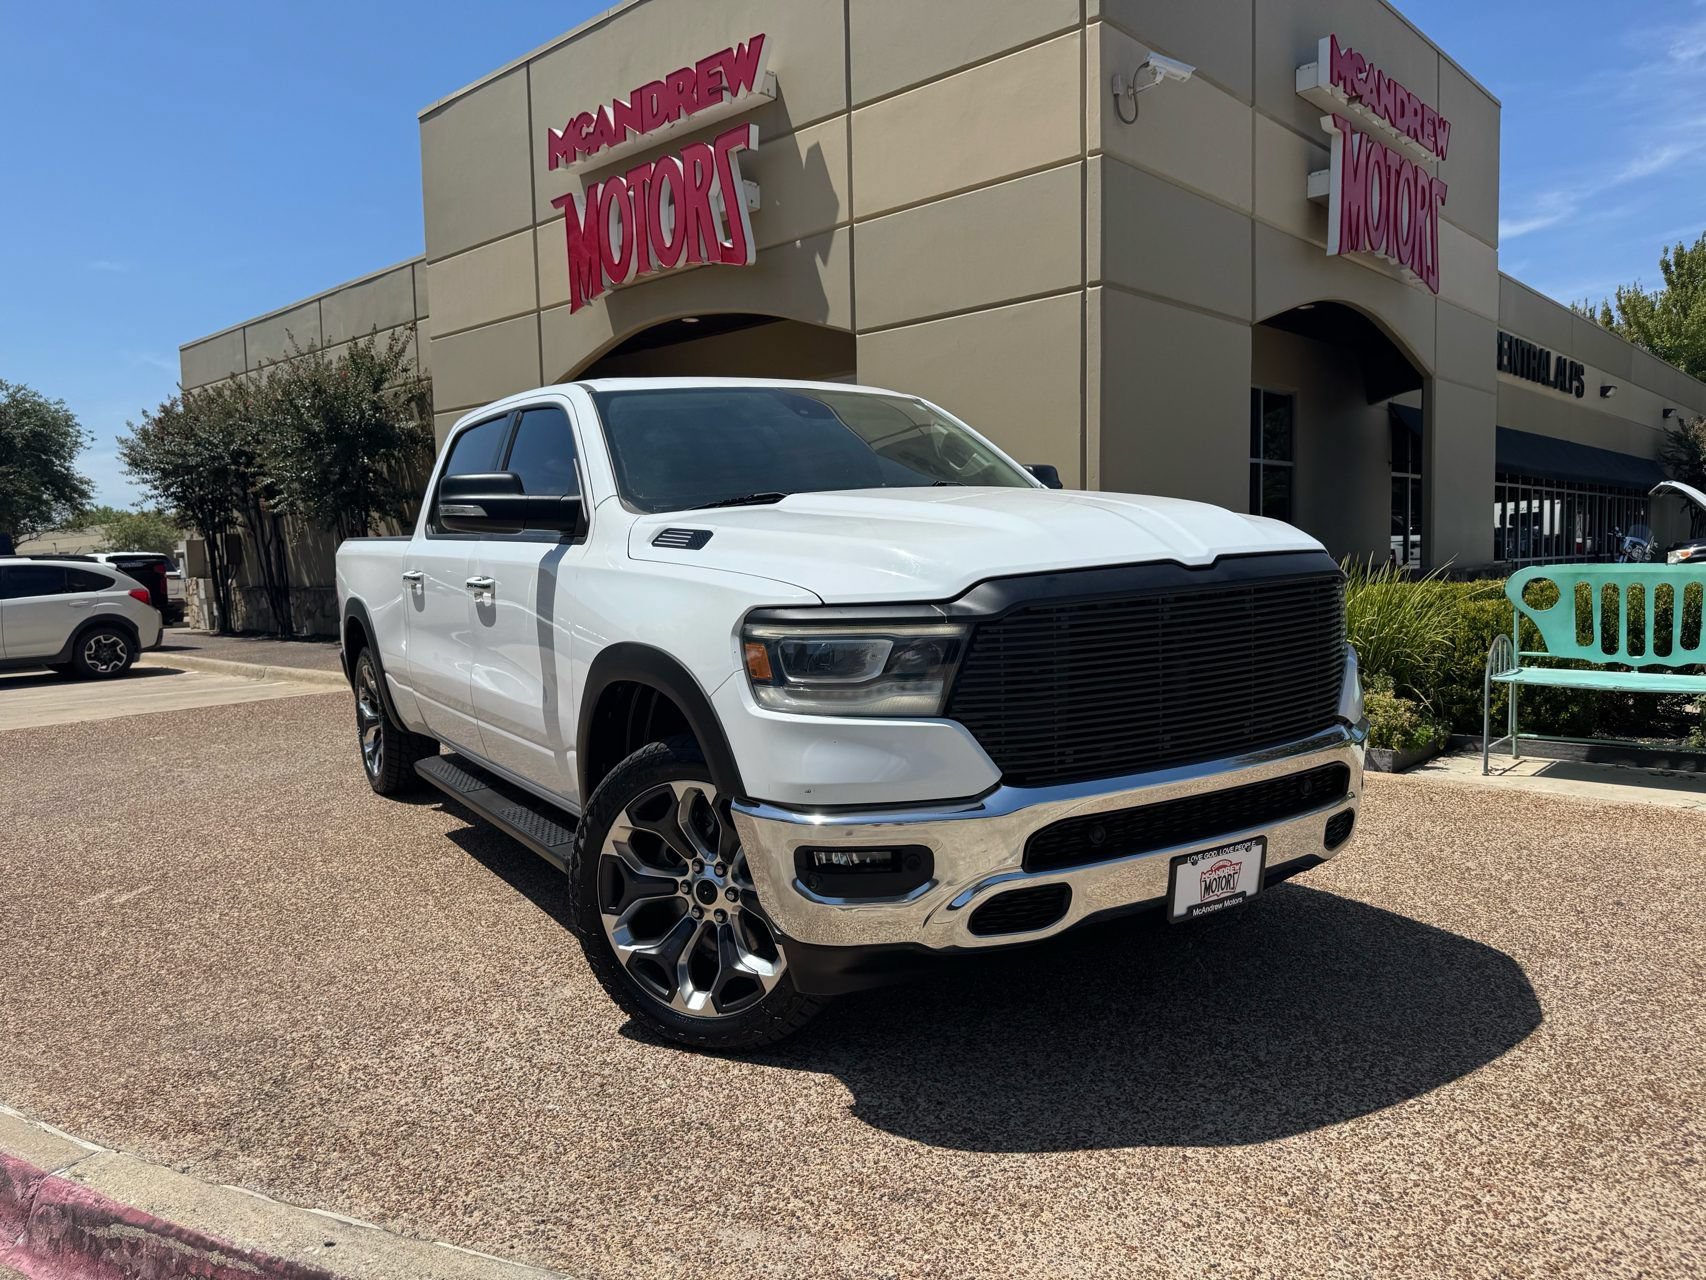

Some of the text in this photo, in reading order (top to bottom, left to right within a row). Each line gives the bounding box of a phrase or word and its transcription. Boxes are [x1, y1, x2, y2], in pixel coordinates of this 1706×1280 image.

[550, 122, 751, 315] MOTORS
[1331, 113, 1448, 294] MOTORS
[1496, 329, 1555, 387] ENTRAL
[1187, 853, 1203, 863] LOVE
[1219, 846, 1235, 856] LOVE
[1192, 896, 1243, 917] McAndrew Motors
[1202, 871, 1239, 899] MOTORS
